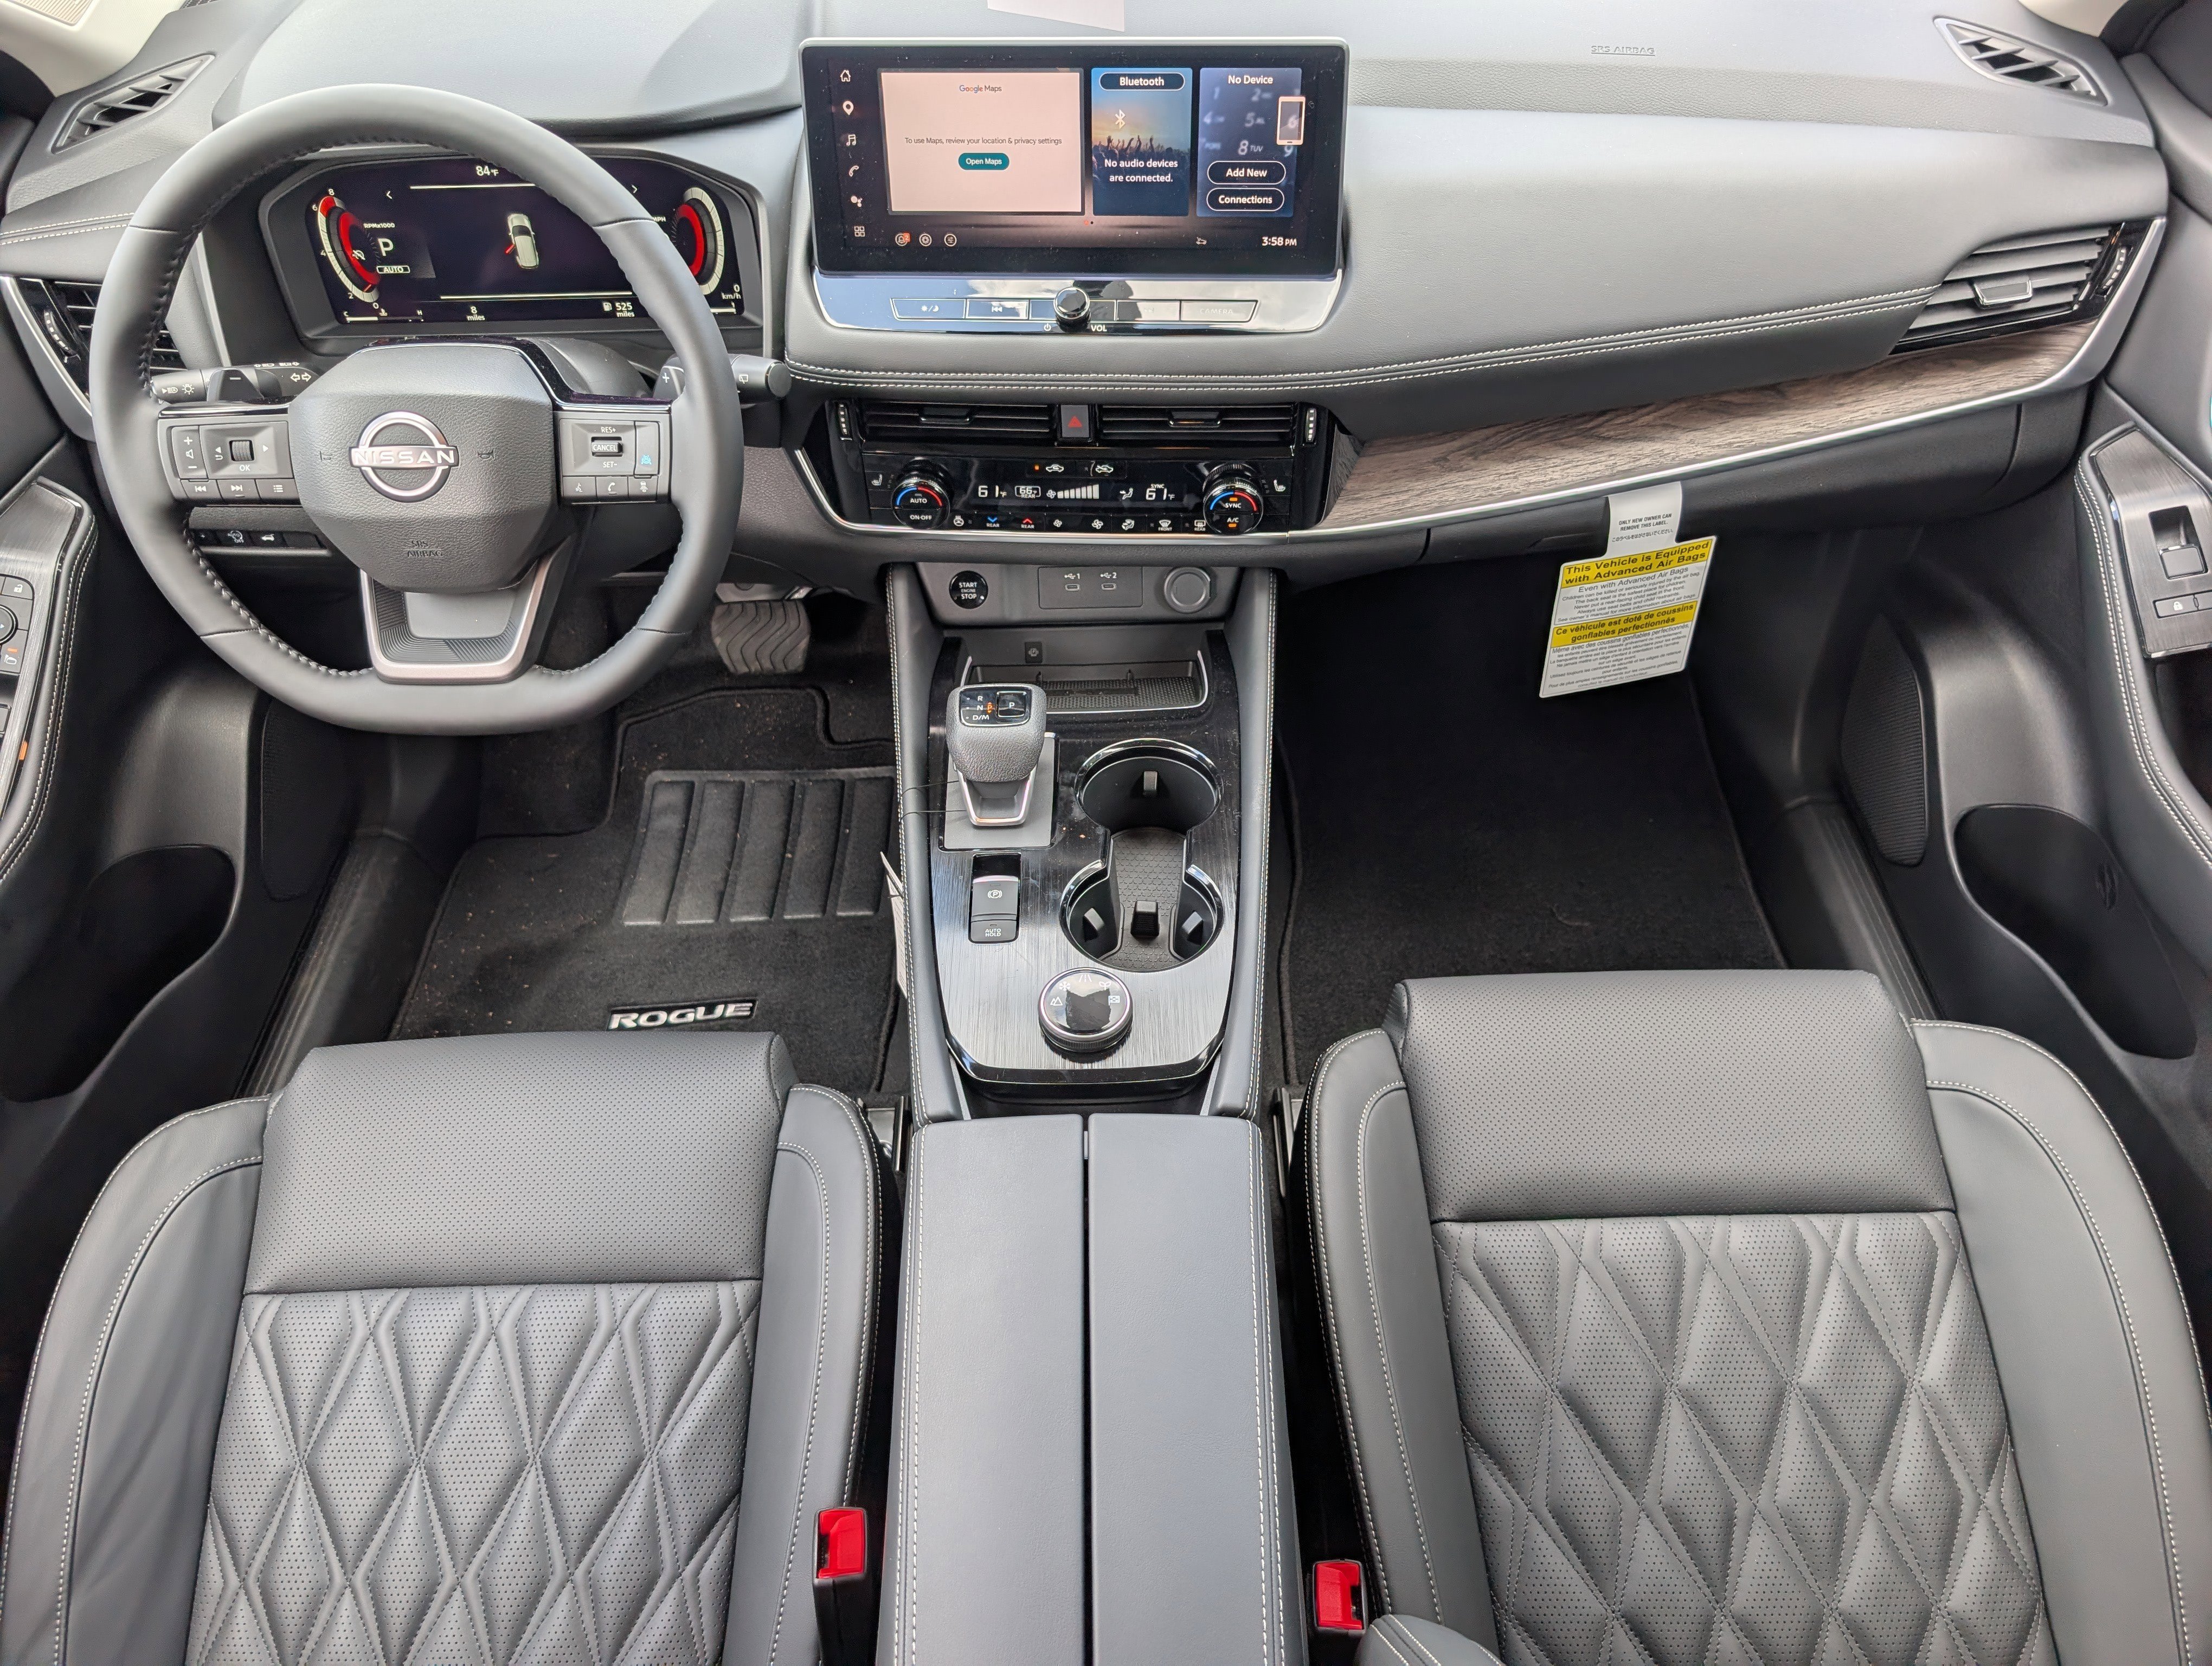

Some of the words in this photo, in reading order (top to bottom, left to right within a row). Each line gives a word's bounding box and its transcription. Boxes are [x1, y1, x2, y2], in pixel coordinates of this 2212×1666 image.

[1120, 76, 1164, 86] Bluetooth
[1228, 75, 1242, 84] No
[1244, 75, 1273, 84] Device
[959, 85, 983, 93] Google
[926, 137, 944, 145] Maps,
[1014, 137, 1037, 145] privacy
[1038, 137, 1062, 145] settings
[1238, 140, 1249, 156] 8
[966, 158, 983, 166] Open
[985, 158, 1002, 166] Maps
[1104, 159, 1117, 168] No
[1119, 159, 1144, 168] audio
[1146, 159, 1178, 168] devices
[1226, 168, 1244, 177] Add
[1246, 168, 1267, 177] New
[1126, 173, 1173, 183] connected.
[1218, 195, 1272, 204] Connections
[1262, 236, 1283, 246] 3:58
[377, 238, 394, 257] P
[734, 284, 740, 292] 0
[471, 306, 477, 314] 8
[615, 302, 633, 311] 525
[1200, 307, 1234, 316] CAMERA
[355, 450, 454, 465] NISSAN
[407, 549, 443, 558] AIRBAG
[1566, 565, 1591, 575] This
[1595, 557, 1637, 570] Vehicle
[1655, 541, 1709, 560] Equipped
[1565, 574, 1590, 585] with
[1594, 562, 1652, 580] Advanced
[1656, 559, 1674, 568] Air
[1677, 553, 1706, 563] Bags
[1618, 574, 1656, 586] Advanced
[1670, 567, 1689, 576] Bags
[1570, 621, 1605, 633] véhicule
[1608, 618, 1622, 627] est
[1623, 614, 1642, 624] doté
[1656, 604, 1694, 617] coussins
[1571, 629, 1616, 643] gonflables
[1617, 616, 1675, 635] perfectionnés
[608, 1002, 753, 1030] ROGUE
